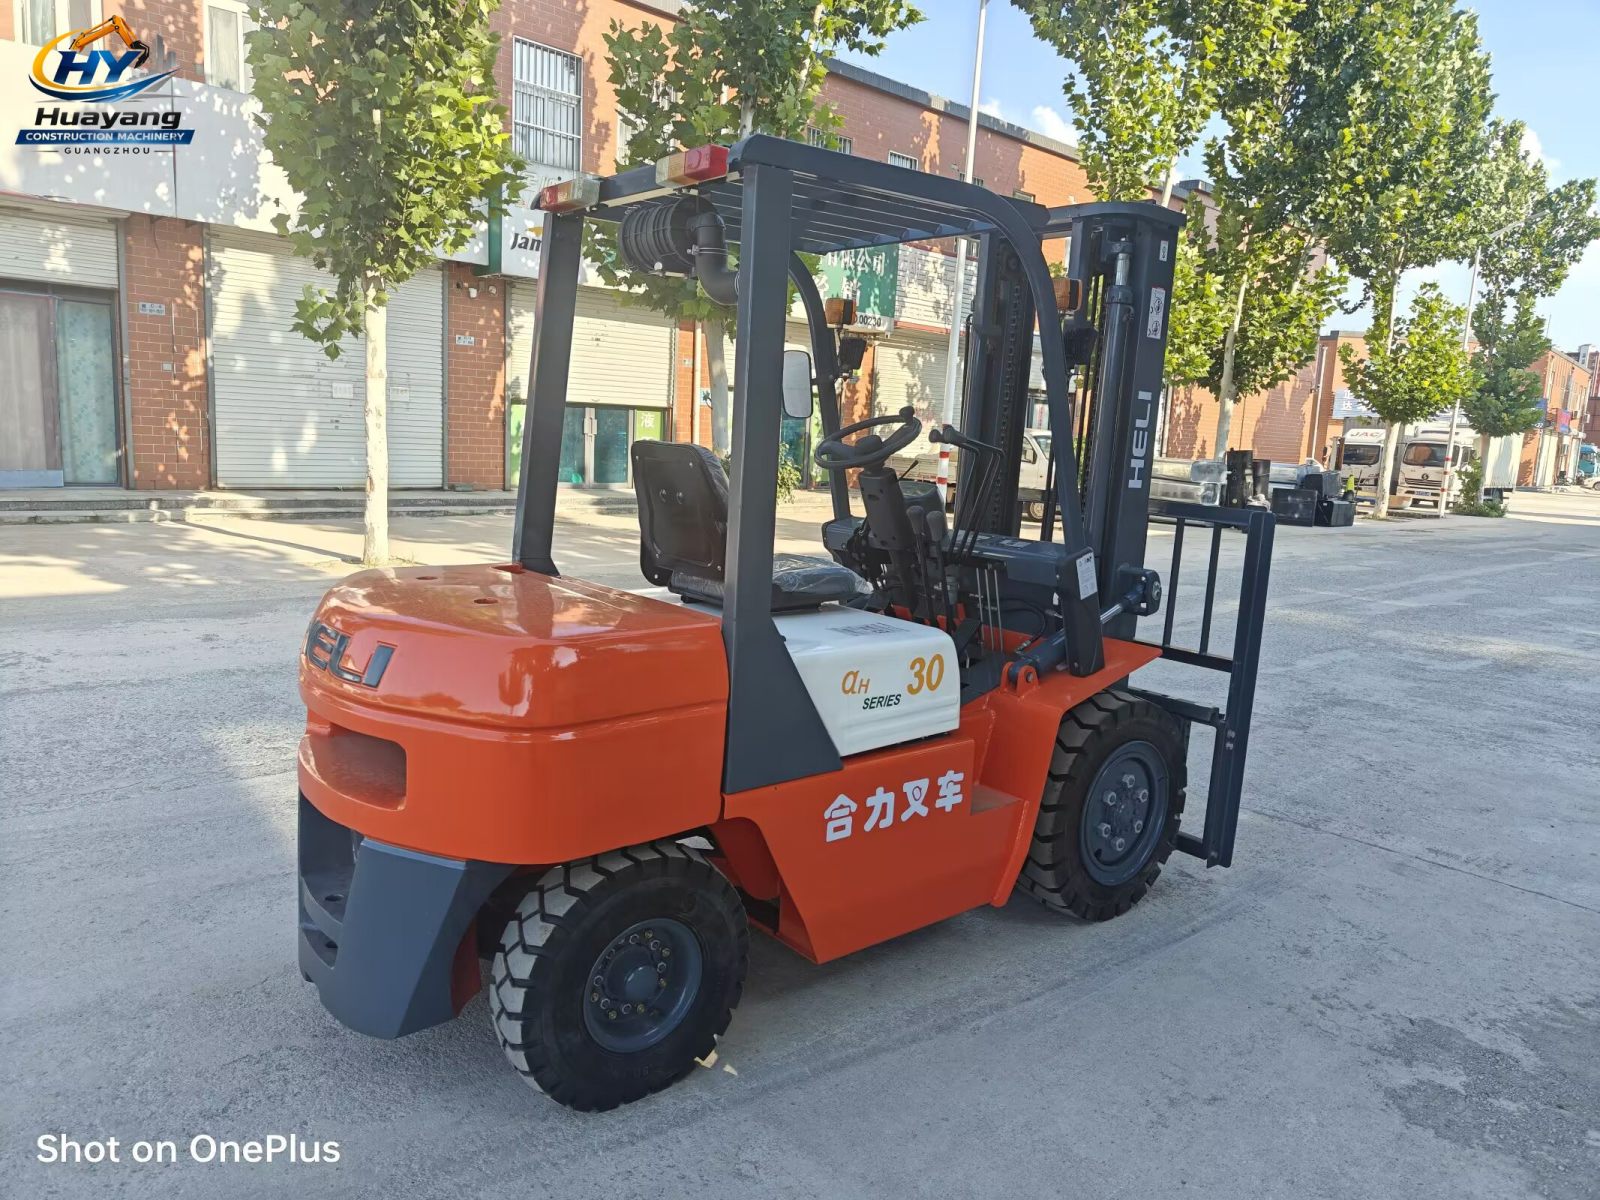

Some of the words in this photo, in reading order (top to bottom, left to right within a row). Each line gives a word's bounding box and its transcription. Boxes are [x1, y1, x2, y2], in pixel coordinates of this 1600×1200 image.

[510, 232, 543, 252] Jan
[859, 315, 882, 327] 00230
[1128, 391, 1152, 489] HELI
[306, 622, 395, 689] ELI
[907, 653, 945, 695] 30
[862, 694, 901, 710] SERIES
[824, 770, 965, 842] 合力叉车
